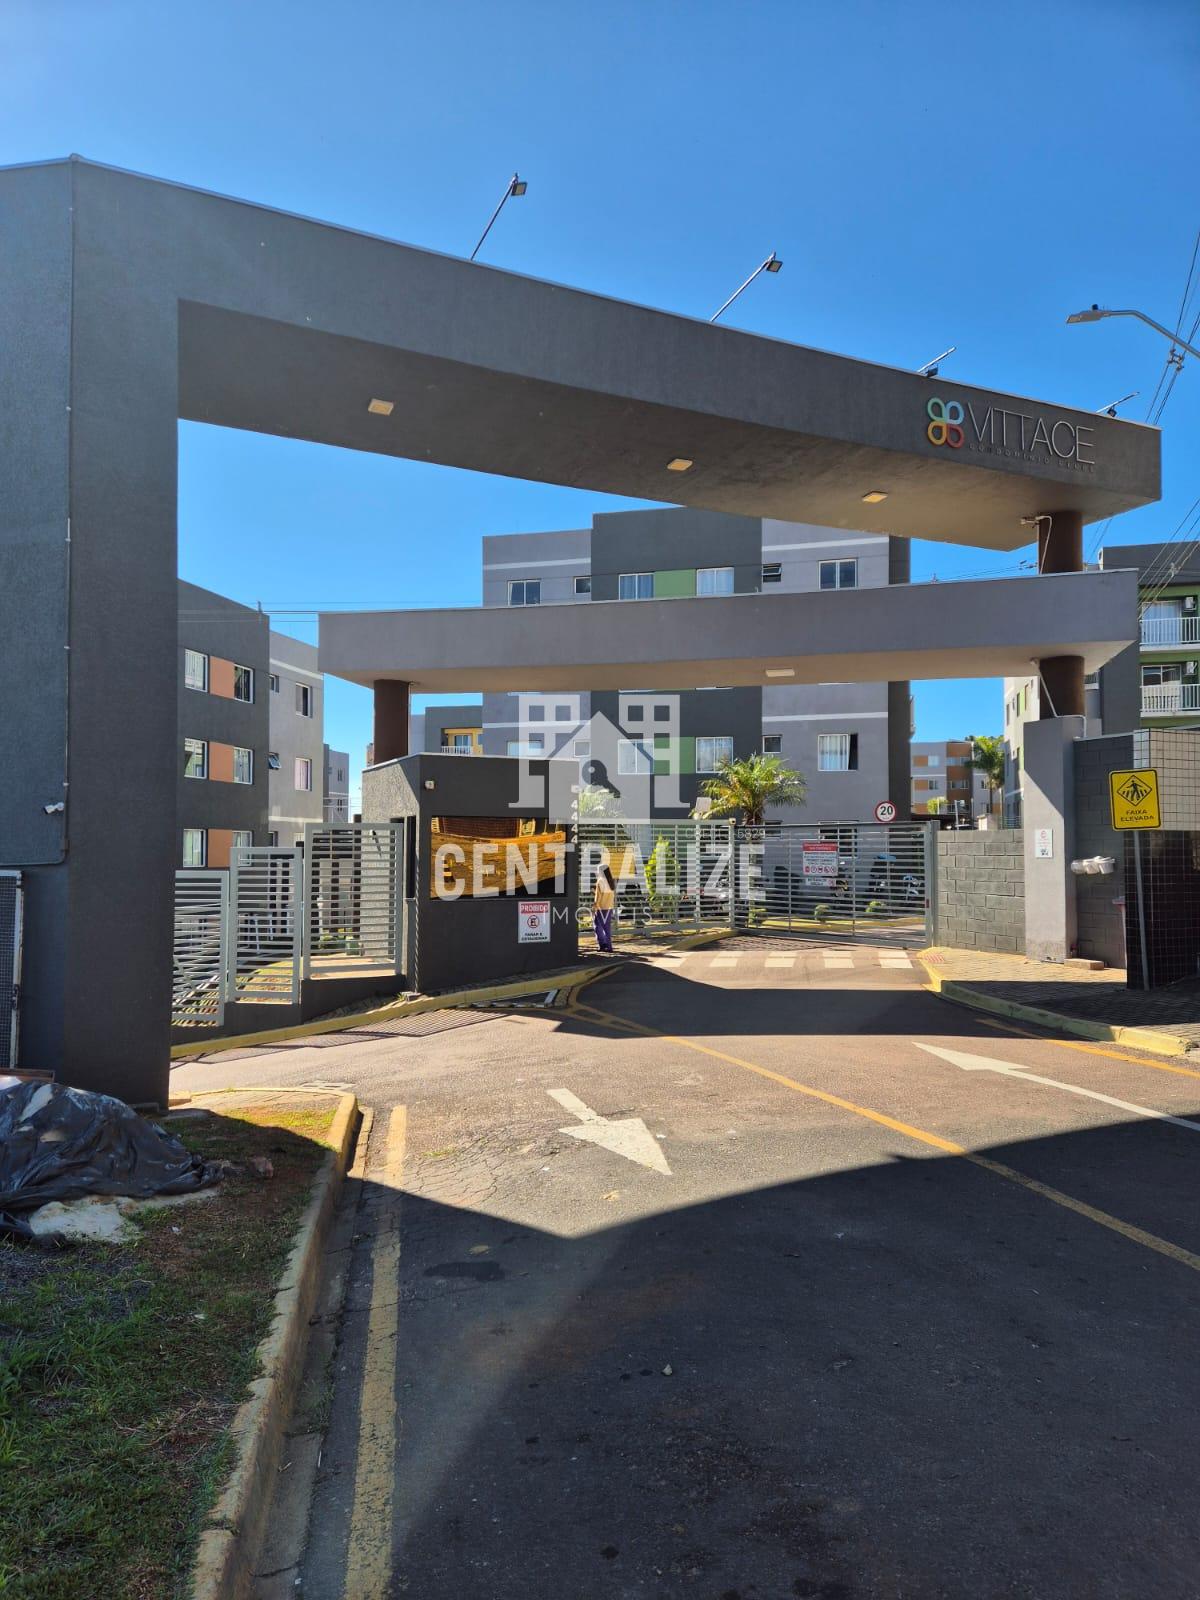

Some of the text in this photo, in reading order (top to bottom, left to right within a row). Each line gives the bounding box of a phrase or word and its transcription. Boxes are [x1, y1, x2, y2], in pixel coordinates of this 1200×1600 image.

[967, 402, 1095, 464] VITTACE
[880, 805, 893, 815] 20
[520, 904, 548, 913] PROIBIDO
